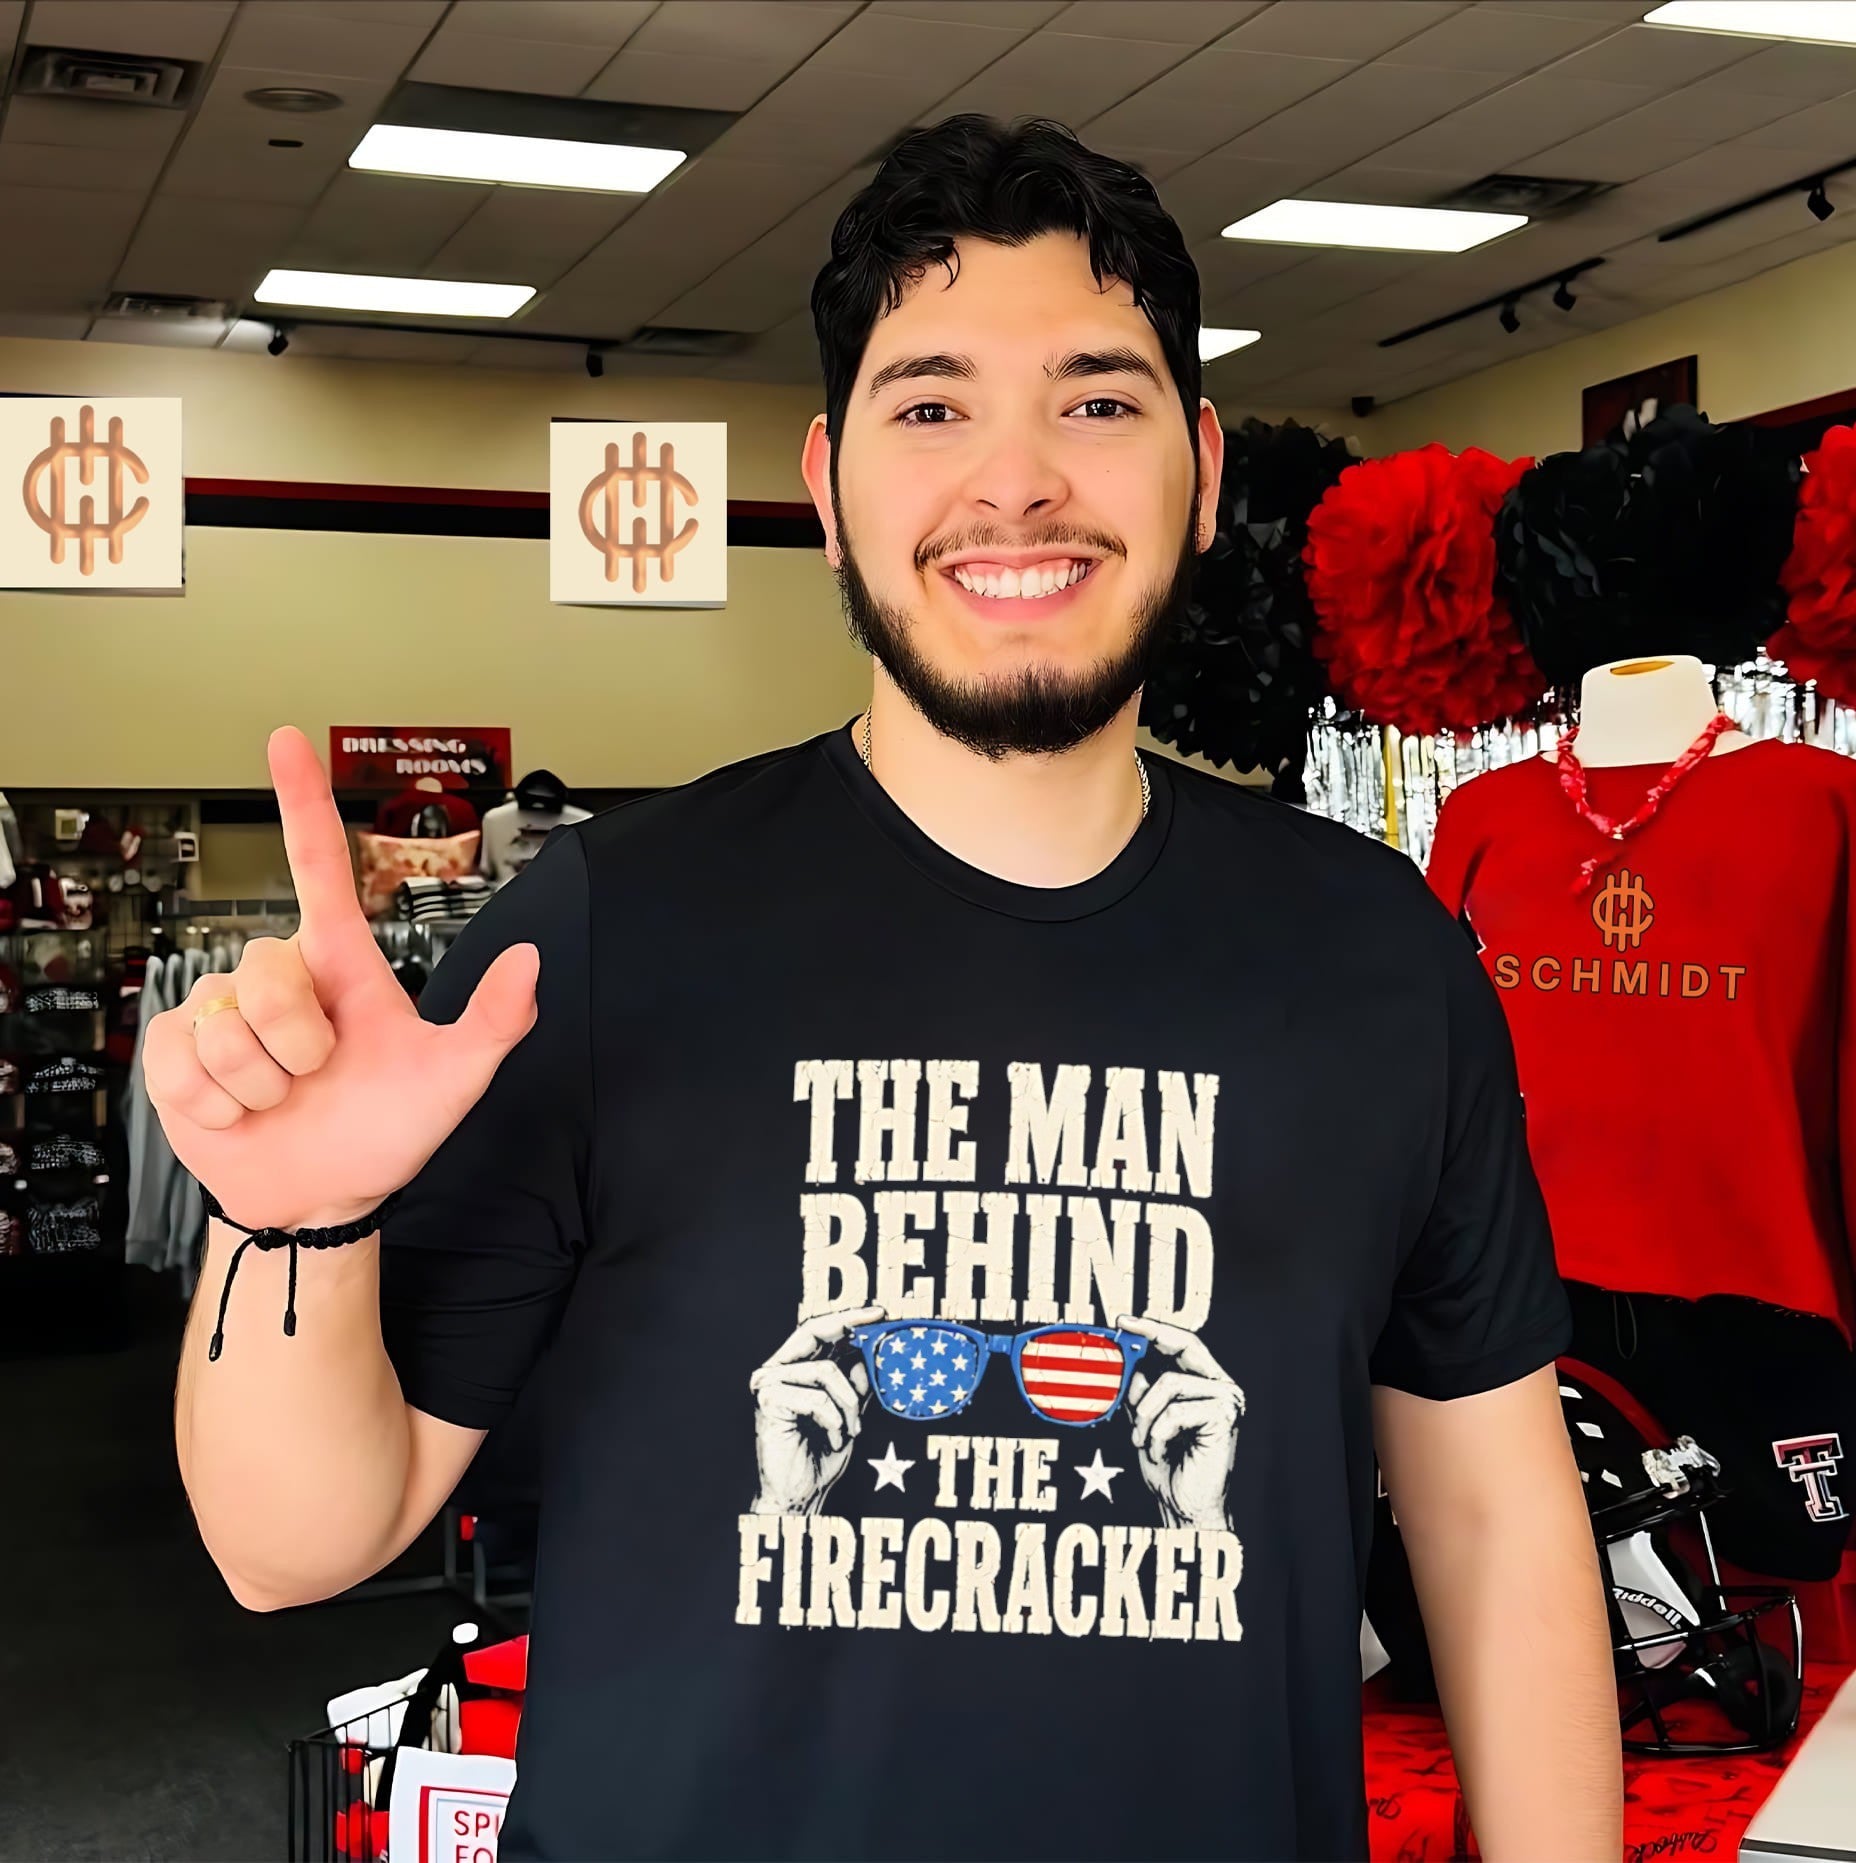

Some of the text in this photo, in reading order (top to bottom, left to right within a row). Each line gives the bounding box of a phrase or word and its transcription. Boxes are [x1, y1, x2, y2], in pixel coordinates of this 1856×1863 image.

[342, 737, 467, 754] DRESSING
[396, 758, 487, 775] ROOMS
[1494, 953, 1747, 1000] SCHMIDT
[793, 1059, 1220, 1198] THE MAN
[797, 1190, 1214, 1333] BEHIND
[926, 1434, 1060, 1512] THE
[735, 1514, 1244, 1642] FIRECRACKER
